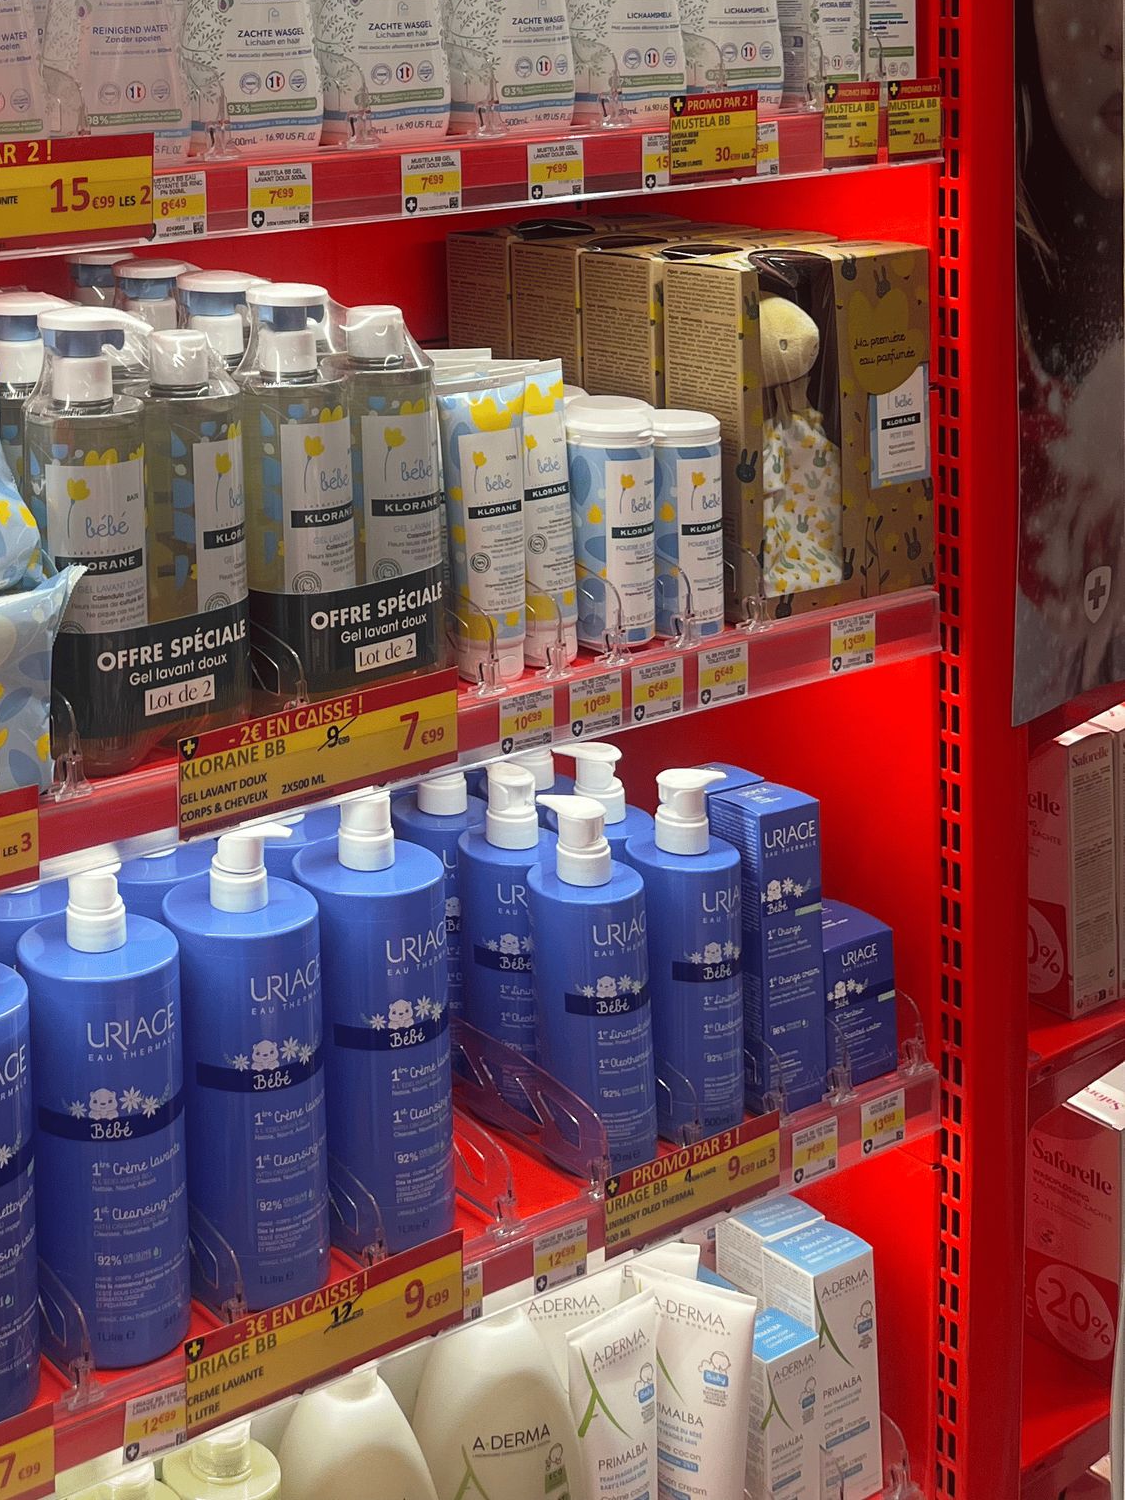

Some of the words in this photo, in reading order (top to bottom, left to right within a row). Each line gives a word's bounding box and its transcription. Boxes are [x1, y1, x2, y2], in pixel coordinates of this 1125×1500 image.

[0, 31, 27, 42] WATER
[28, 142, 39, 162] 2
[119, 194, 136, 207] LES
[140, 185, 150, 206] 2
[268, 187, 293, 203] 7€99
[477, 503, 518, 515] KLORANE
[97, 641, 165, 672] OFFRE
[170, 619, 247, 659] SPÉCIALE
[129, 671, 152, 686] Gel
[155, 662, 194, 681] lavant
[195, 652, 227, 675] doux
[148, 691, 173, 711] Lot
[178, 684, 198, 704] de
[201, 679, 213, 697] 2
[266, 718, 290, 739] EN
[294, 702, 353, 731] CAISSE
[180, 746, 260, 781] KLORANE
[265, 739, 286, 760] BB
[764, 820, 816, 850] URIAGE
[632, 1151, 689, 1186] PROMO
[692, 1140, 719, 1164] PAR
[723, 1137, 732, 1152] 3
[1031, 1137, 1112, 1196] Saforelle
[606, 1185, 650, 1214] URIAGE
[653, 1177, 668, 1194] BB
[186, 1344, 251, 1385] URIAGE
[255, 1333, 277, 1355] BB
[598, 1442, 647, 1470] PRIMALBA
